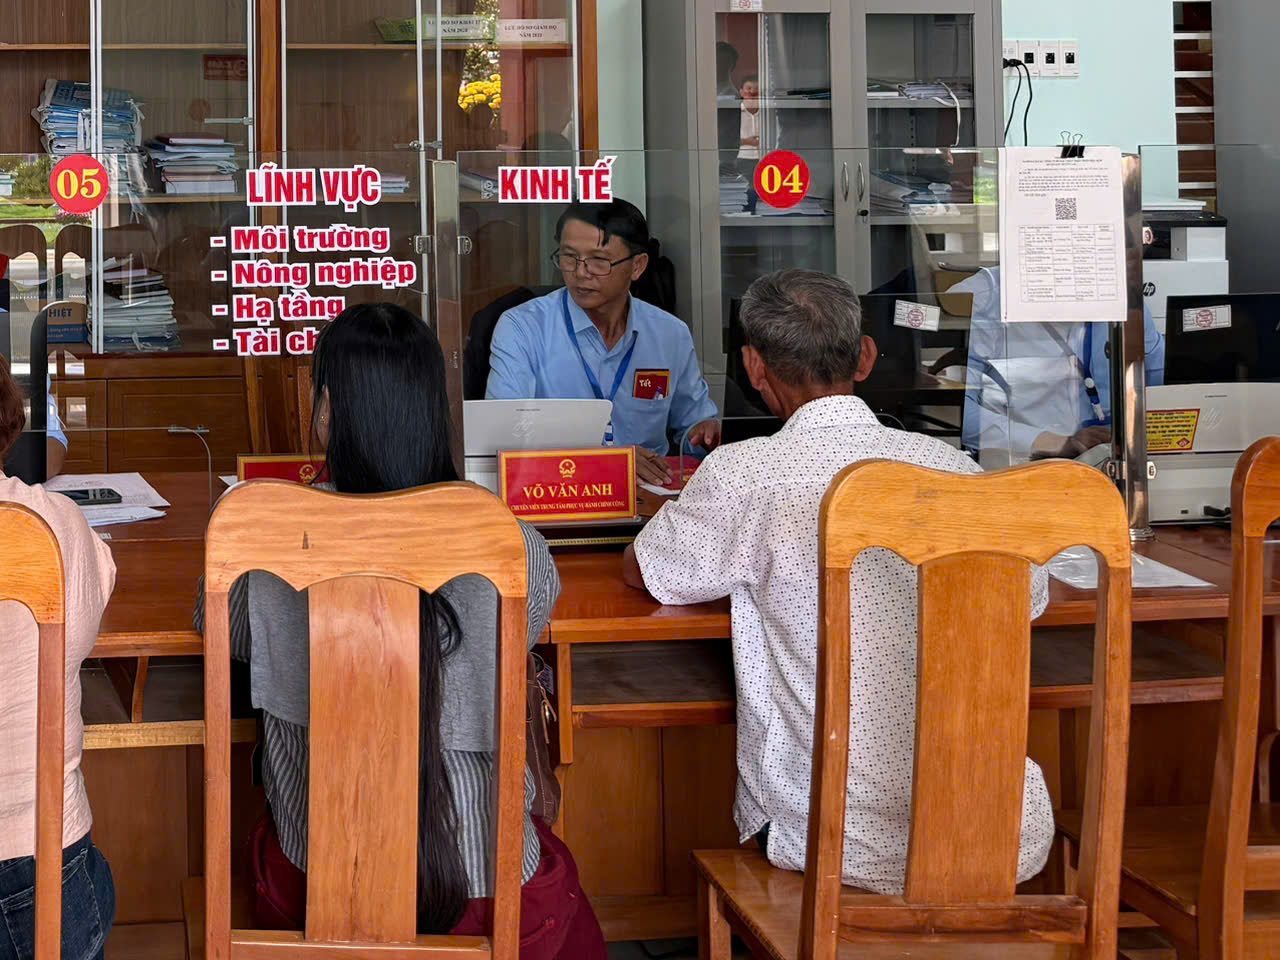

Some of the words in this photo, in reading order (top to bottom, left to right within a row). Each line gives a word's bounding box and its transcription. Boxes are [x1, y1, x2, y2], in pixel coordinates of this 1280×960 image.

[56, 168, 102, 200] 05
[248, 164, 314, 203] LĨNH
[322, 167, 379, 209] VỰC
[500, 168, 569, 200] KINH
[578, 158, 613, 200] TẾ
[760, 164, 804, 194] 04
[234, 227, 287, 250] Môi
[296, 226, 388, 250] trường
[234, 262, 308, 285] Nông
[319, 259, 414, 286] nghiệp
[48, 306, 73, 319] HIỆT
[235, 296, 272, 323] Hạ
[280, 291, 344, 320] tầng
[235, 329, 278, 353] Tài
[523, 483, 545, 499] VÕ
[548, 482, 578, 498] VĂN
[581, 483, 613, 497] ANH
